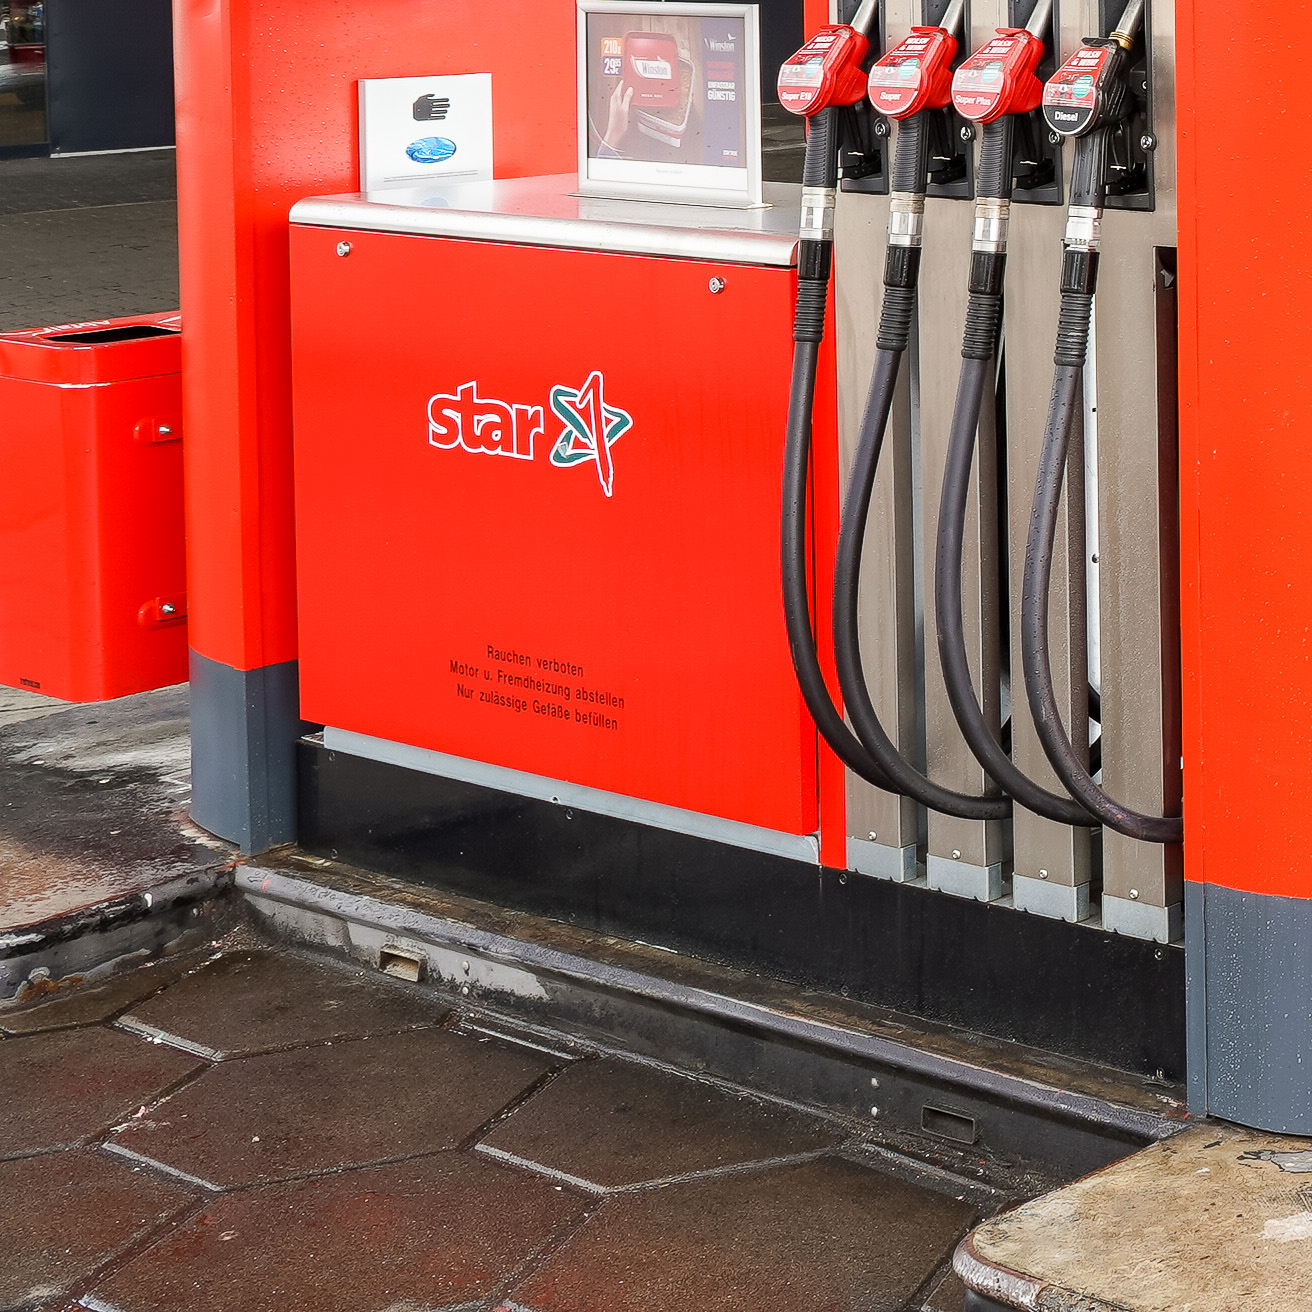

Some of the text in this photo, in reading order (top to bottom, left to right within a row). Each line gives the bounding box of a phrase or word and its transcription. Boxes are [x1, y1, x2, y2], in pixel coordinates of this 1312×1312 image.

[879, 91, 901, 102] Super
[955, 94, 975, 106] Super
[1054, 110, 1079, 122] Diesel
[427, 381, 545, 461] star
[487, 645, 584, 678] Rauchen verboten
[450, 660, 625, 710] Motor u. Fremdheizung abstellen
[457, 684, 618, 731] Nur zulässige Gefäße befüllen
